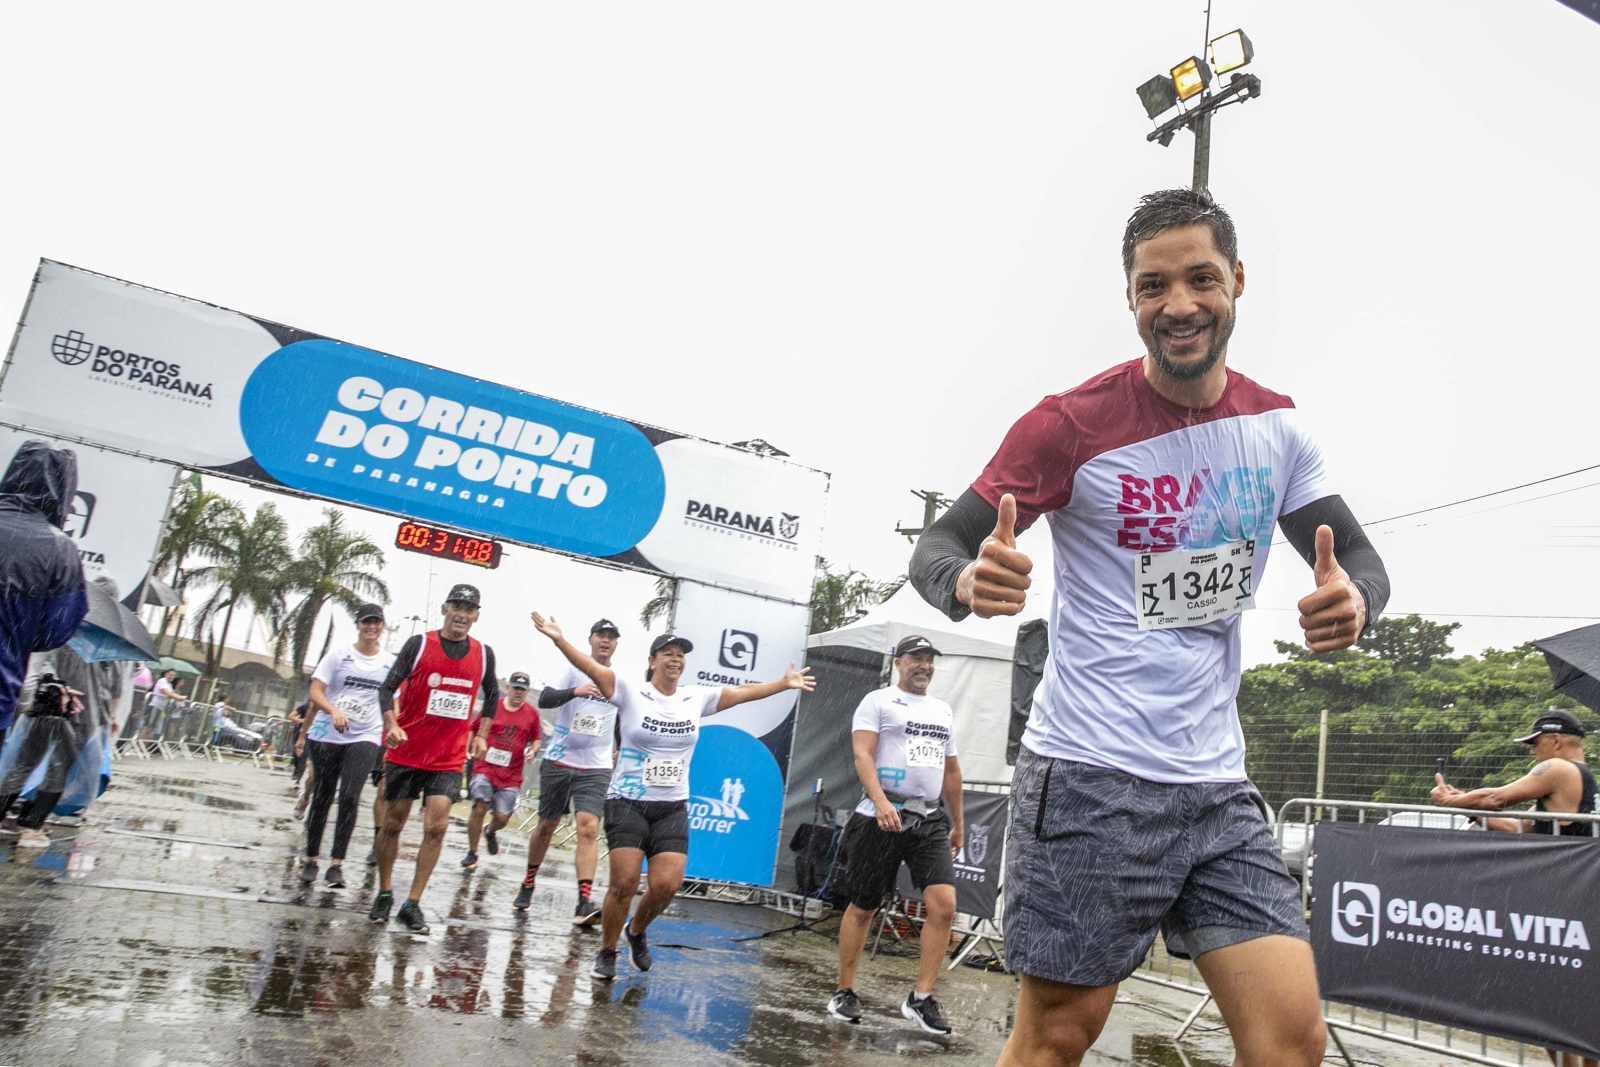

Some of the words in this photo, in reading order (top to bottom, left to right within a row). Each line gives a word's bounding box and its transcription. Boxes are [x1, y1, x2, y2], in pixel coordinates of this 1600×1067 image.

[96, 345, 181, 377] PORTOS
[91, 359, 123, 377] DO
[128, 367, 213, 400] PARANÁ
[337, 376, 595, 469] CORRIDA
[305, 453, 337, 468] DE
[315, 410, 409, 459] DO
[413, 435, 607, 508] PORTO
[1117, 467, 1276, 514] BRAVES
[686, 499, 775, 536] PARANÁ
[398, 524, 493, 562] 00:31:08
[1162, 562, 1234, 601] 1342
[1186, 597, 1218, 610] CASSIO
[697, 670, 741, 686] GLOBAL
[437, 697, 463, 710] 1069
[641, 722, 658, 732] DO
[660, 724, 695, 735] PORTO
[643, 716, 692, 728] CORRIDA
[904, 727, 920, 736] DO
[652, 766, 679, 777] 1358
[688, 815, 737, 834] orrer
[954, 870, 986, 883] STADO
[1386, 898, 1503, 938] GLOBAL
[1509, 913, 1591, 951] VITA
[1385, 930, 1473, 952] MARKETING
[1481, 943, 1583, 969] ESPORTIVO
